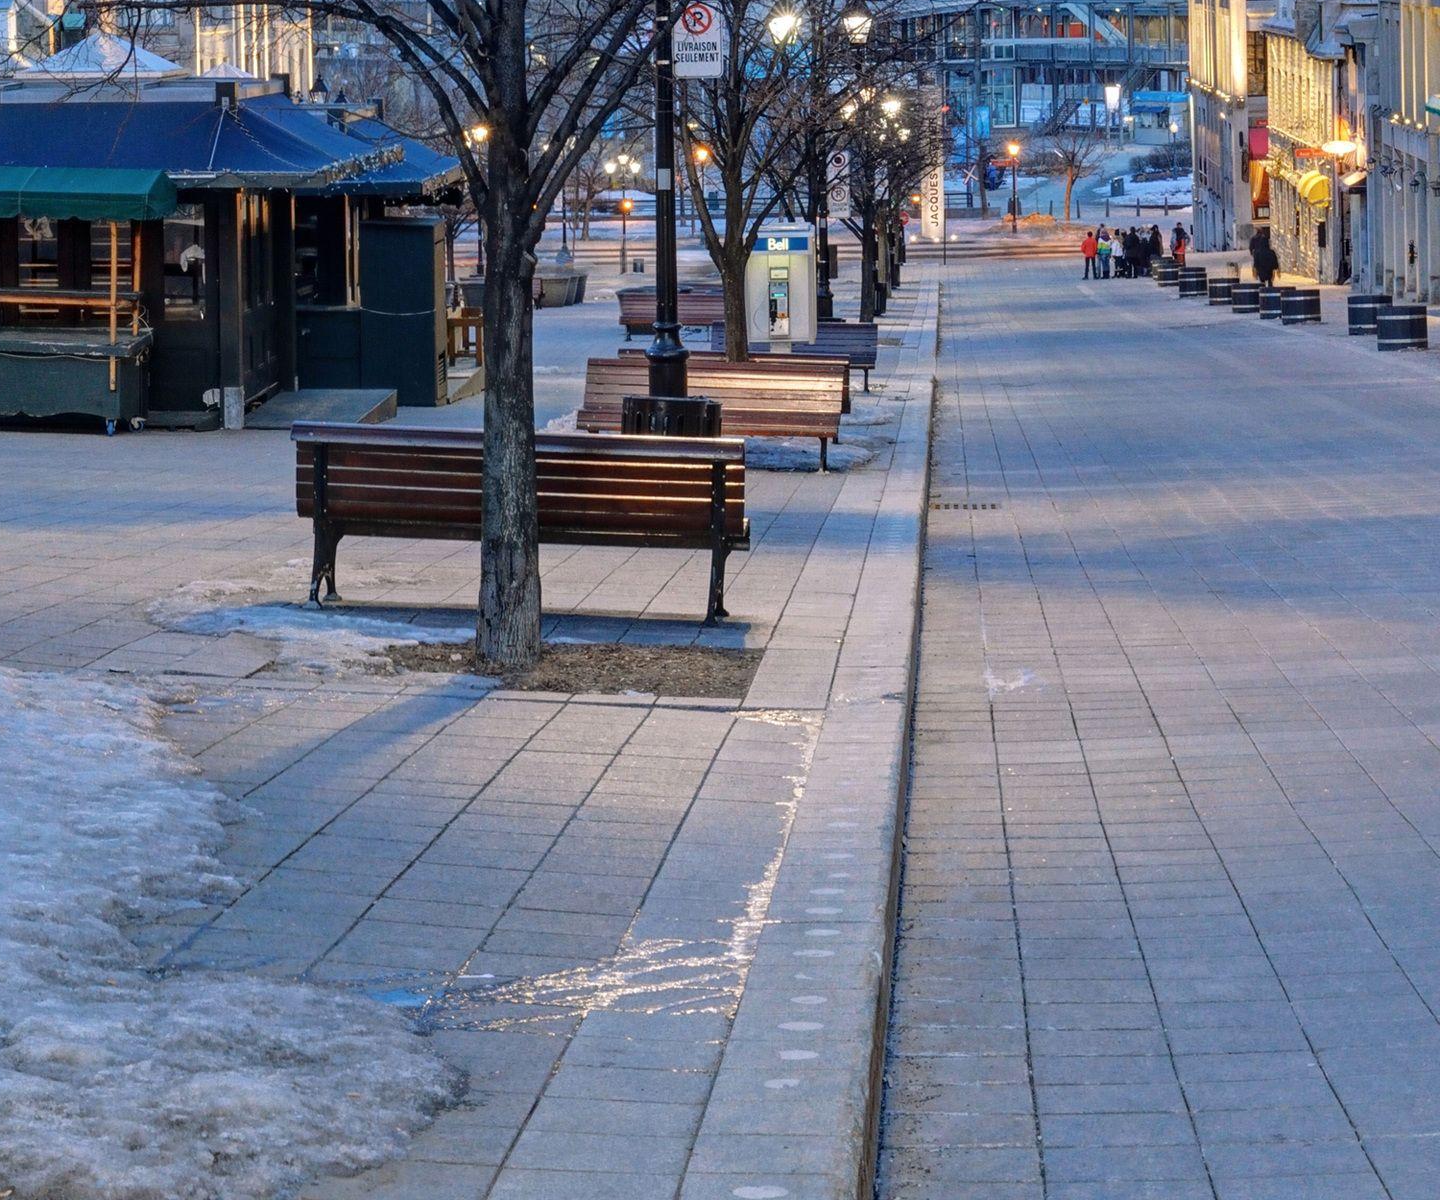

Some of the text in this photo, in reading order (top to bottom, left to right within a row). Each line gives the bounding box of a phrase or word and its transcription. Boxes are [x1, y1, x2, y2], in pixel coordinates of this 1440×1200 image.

[677, 41, 718, 52] LIVRAISON
[675, 52, 720, 63] SEULEMENT
[768, 238, 789, 251] Bell
